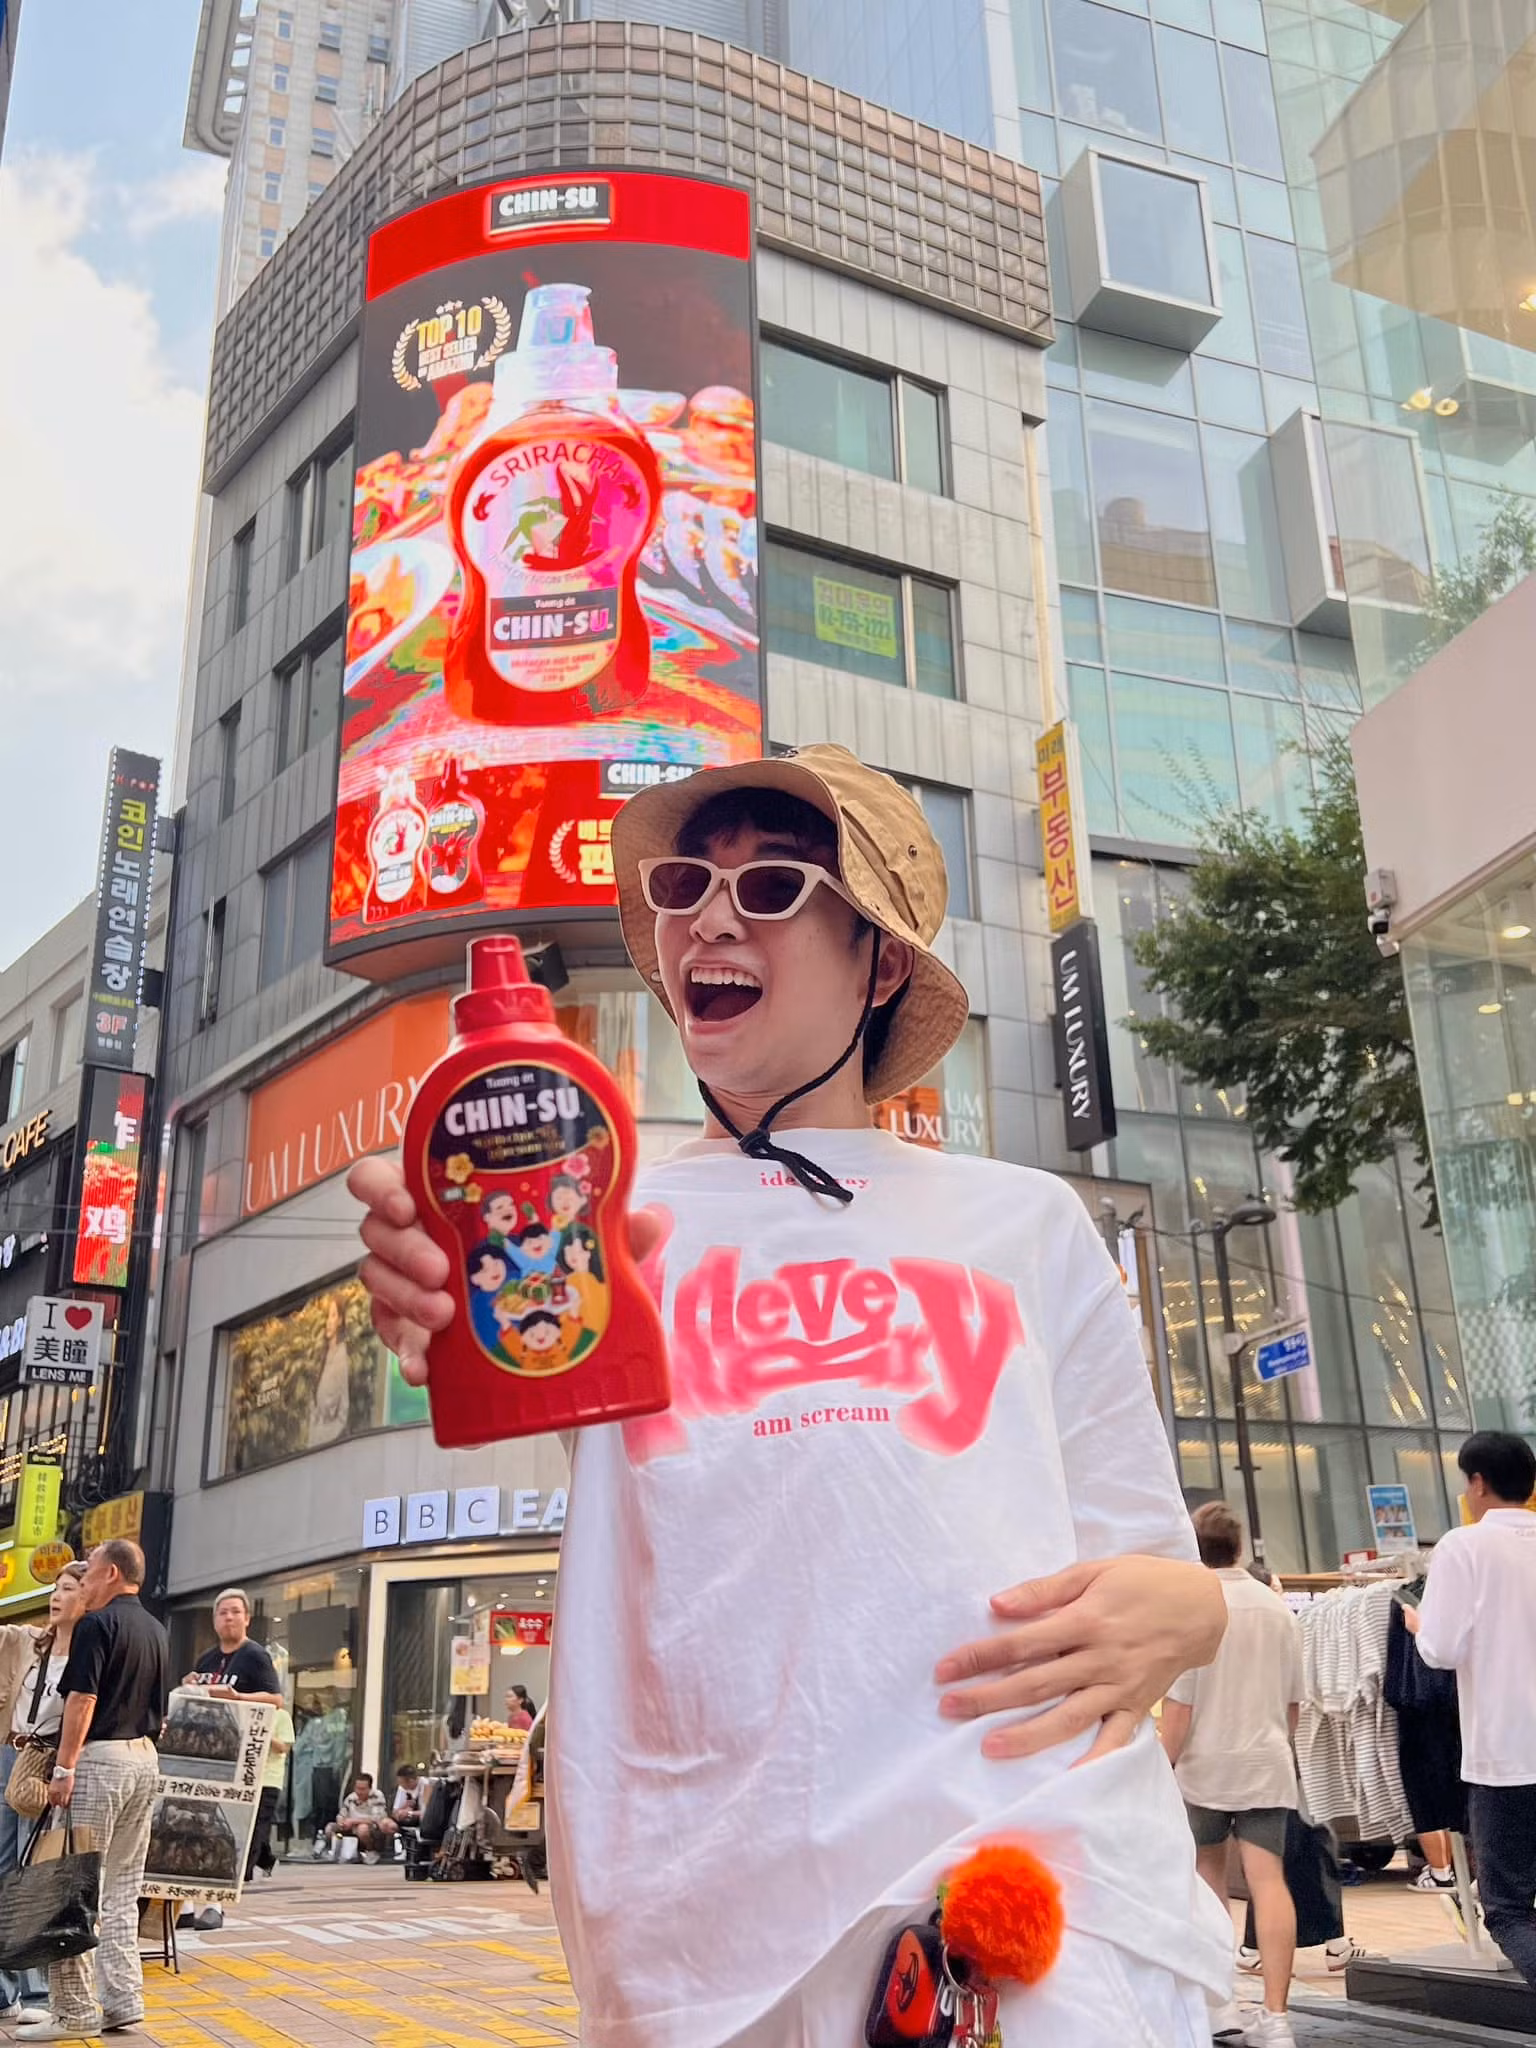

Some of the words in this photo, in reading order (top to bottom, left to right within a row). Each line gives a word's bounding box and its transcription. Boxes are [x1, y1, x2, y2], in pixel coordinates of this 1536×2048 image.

[499, 186, 597, 216] CHIN-SU
[416, 314, 453, 351] TOP
[455, 305, 482, 338] 10
[490, 442, 624, 488] SRIRACHA
[493, 608, 611, 640] CHIN-SU
[1041, 762, 1075, 911] 부동산
[1059, 949, 1081, 1003] UM
[96, 1011, 128, 1035] 3F
[1064, 1006, 1092, 1120] LUXURY
[445, 1087, 581, 1136] CHIN-SU
[945, 1089, 981, 1118] UM
[4, 1110, 49, 1168] CAFE
[889, 1108, 984, 1148] LUXURY
[246, 1142, 289, 1212] UM
[33, 1336, 89, 1365] 美瞳
[31, 1367, 66, 1382] LENS
[68, 1372, 87, 1383] ME
[753, 1416, 793, 1438] am
[799, 1403, 891, 1430] scream
[369, 1493, 493, 1541] BBC
